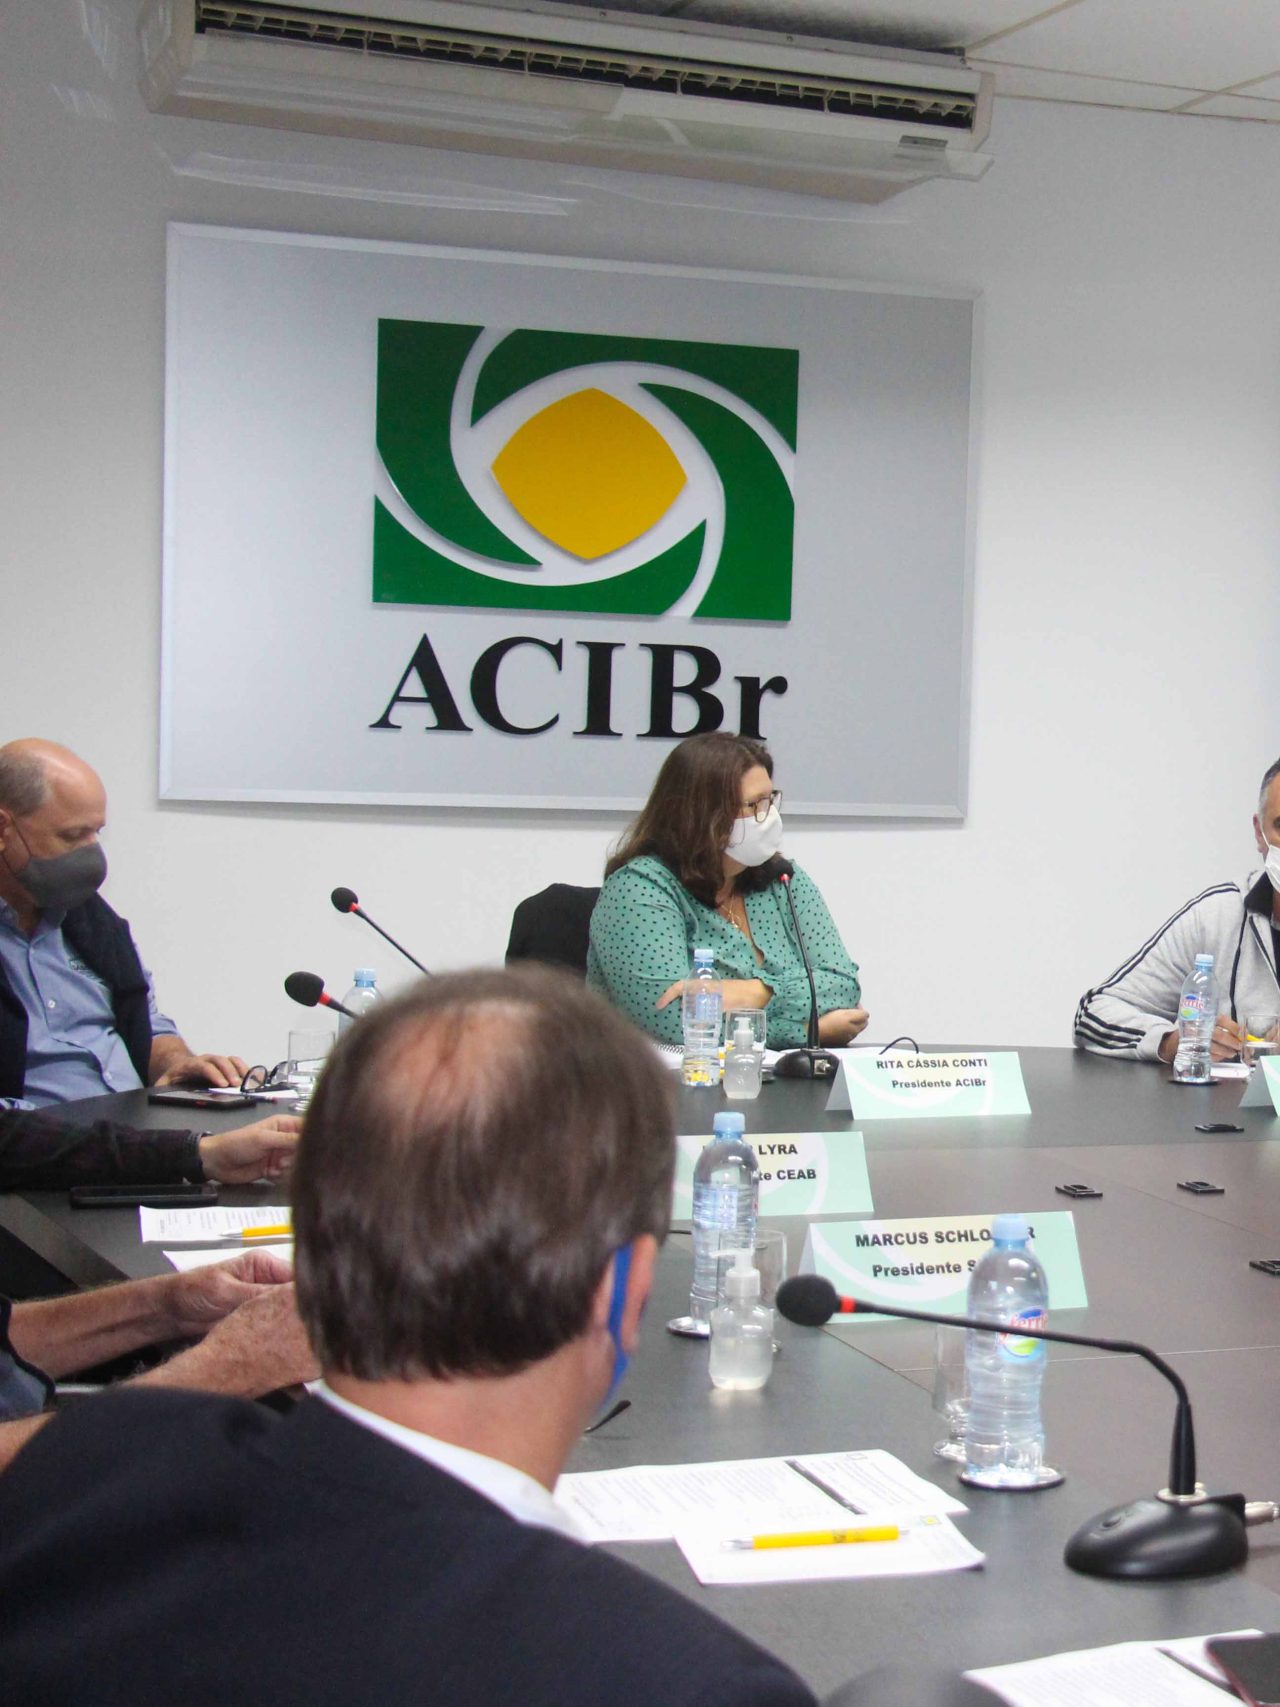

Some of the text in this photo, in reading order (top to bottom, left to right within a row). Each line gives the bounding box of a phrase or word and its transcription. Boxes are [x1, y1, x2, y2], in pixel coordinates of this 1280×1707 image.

[368, 632, 788, 741] ACIBr
[876, 1060, 904, 1070] RITA
[952, 1058, 988, 1068] CONTI
[891, 1078, 987, 1089] Presidente ACIBr
[758, 1143, 799, 1155] LYRA
[776, 1168, 817, 1181] CEAB
[855, 1230, 929, 1248] MARCUS
[872, 1260, 962, 1278] Presidente
